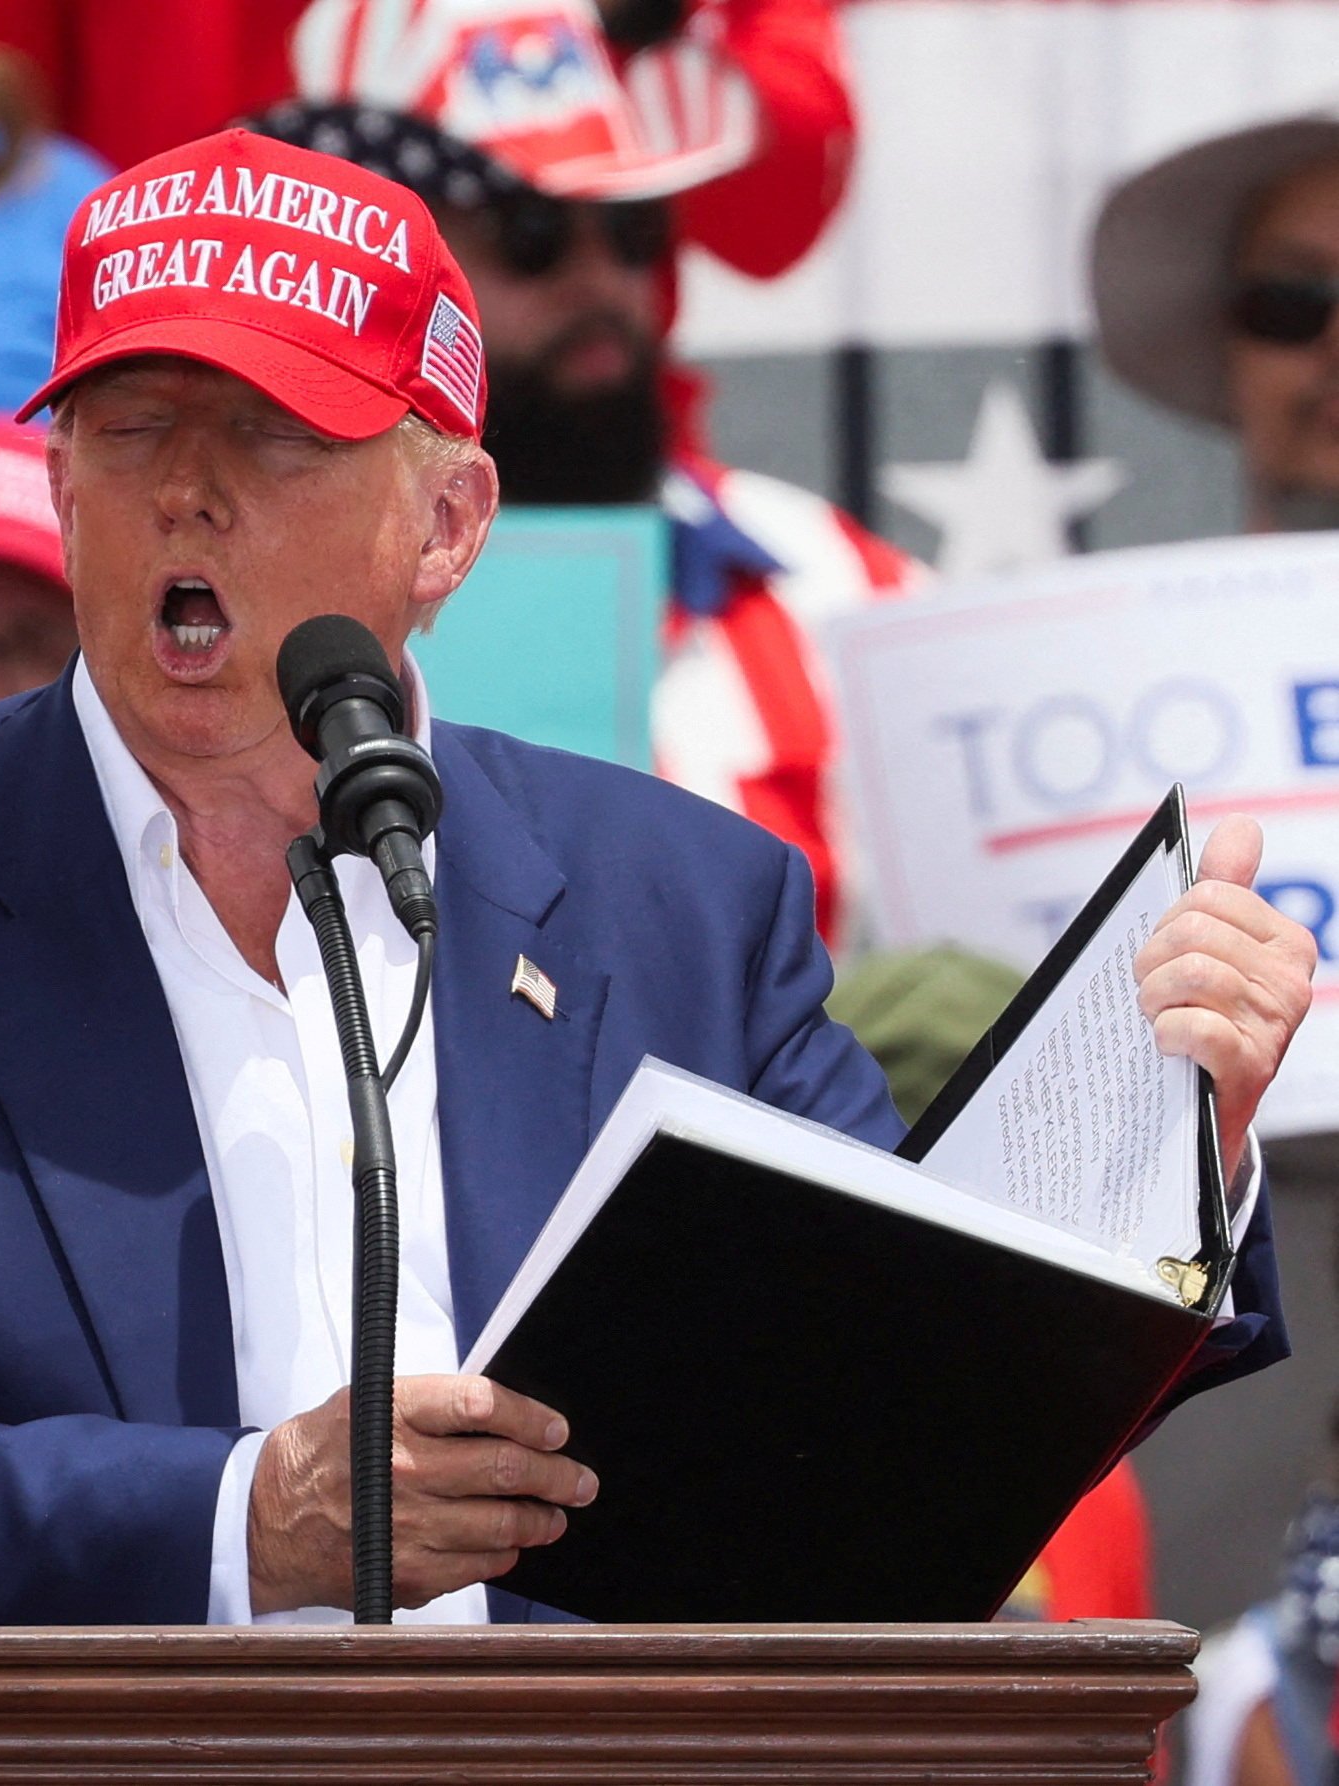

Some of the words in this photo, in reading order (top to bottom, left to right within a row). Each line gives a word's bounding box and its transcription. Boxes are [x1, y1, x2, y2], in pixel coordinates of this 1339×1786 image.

[80, 170, 196, 248] MAKE
[195, 165, 412, 274] AMERICA
[93, 238, 223, 311] GREAT
[222, 244, 378, 337] AGAIN
[930, 675, 1250, 820] TOO
[1126, 927, 1137, 958] cas
[1101, 957, 1115, 1017] beaten
[1114, 944, 1130, 1006] student
[1077, 988, 1088, 1037] loose
[1109, 1019, 1121, 1051] and
[1123, 1005, 1134, 1045] from
[1035, 1042, 1047, 1072] TO
[1060, 1010, 1074, 1075] Instead
[1083, 1036, 1093, 1071] into
[1089, 973, 1101, 1024] Biden
[1095, 1025, 1110, 1089] migrant
[1103, 1090, 1113, 1127] after
[1010, 1078, 1023, 1123] could
[1039, 1073, 1051, 1116] HER
[1067, 1077, 1078, 1095] of
[1087, 1073, 1096, 1099] our
[1114, 1054, 1126, 1132] murdered
[1127, 1046, 1139, 1112] Georgia
[1055, 1085, 1067, 1131] weak
[998, 1094, 1012, 1163] correctly
[1006, 1163, 1014, 1183] in
[1016, 1125, 1026, 1154] not
[1030, 1129, 1042, 1163] And
[1043, 1115, 1058, 1183] KILLER
[1059, 1134, 1068, 1163] Joe
[1070, 1097, 1083, 1189] apologizing
[1019, 1155, 1027, 1196] even
